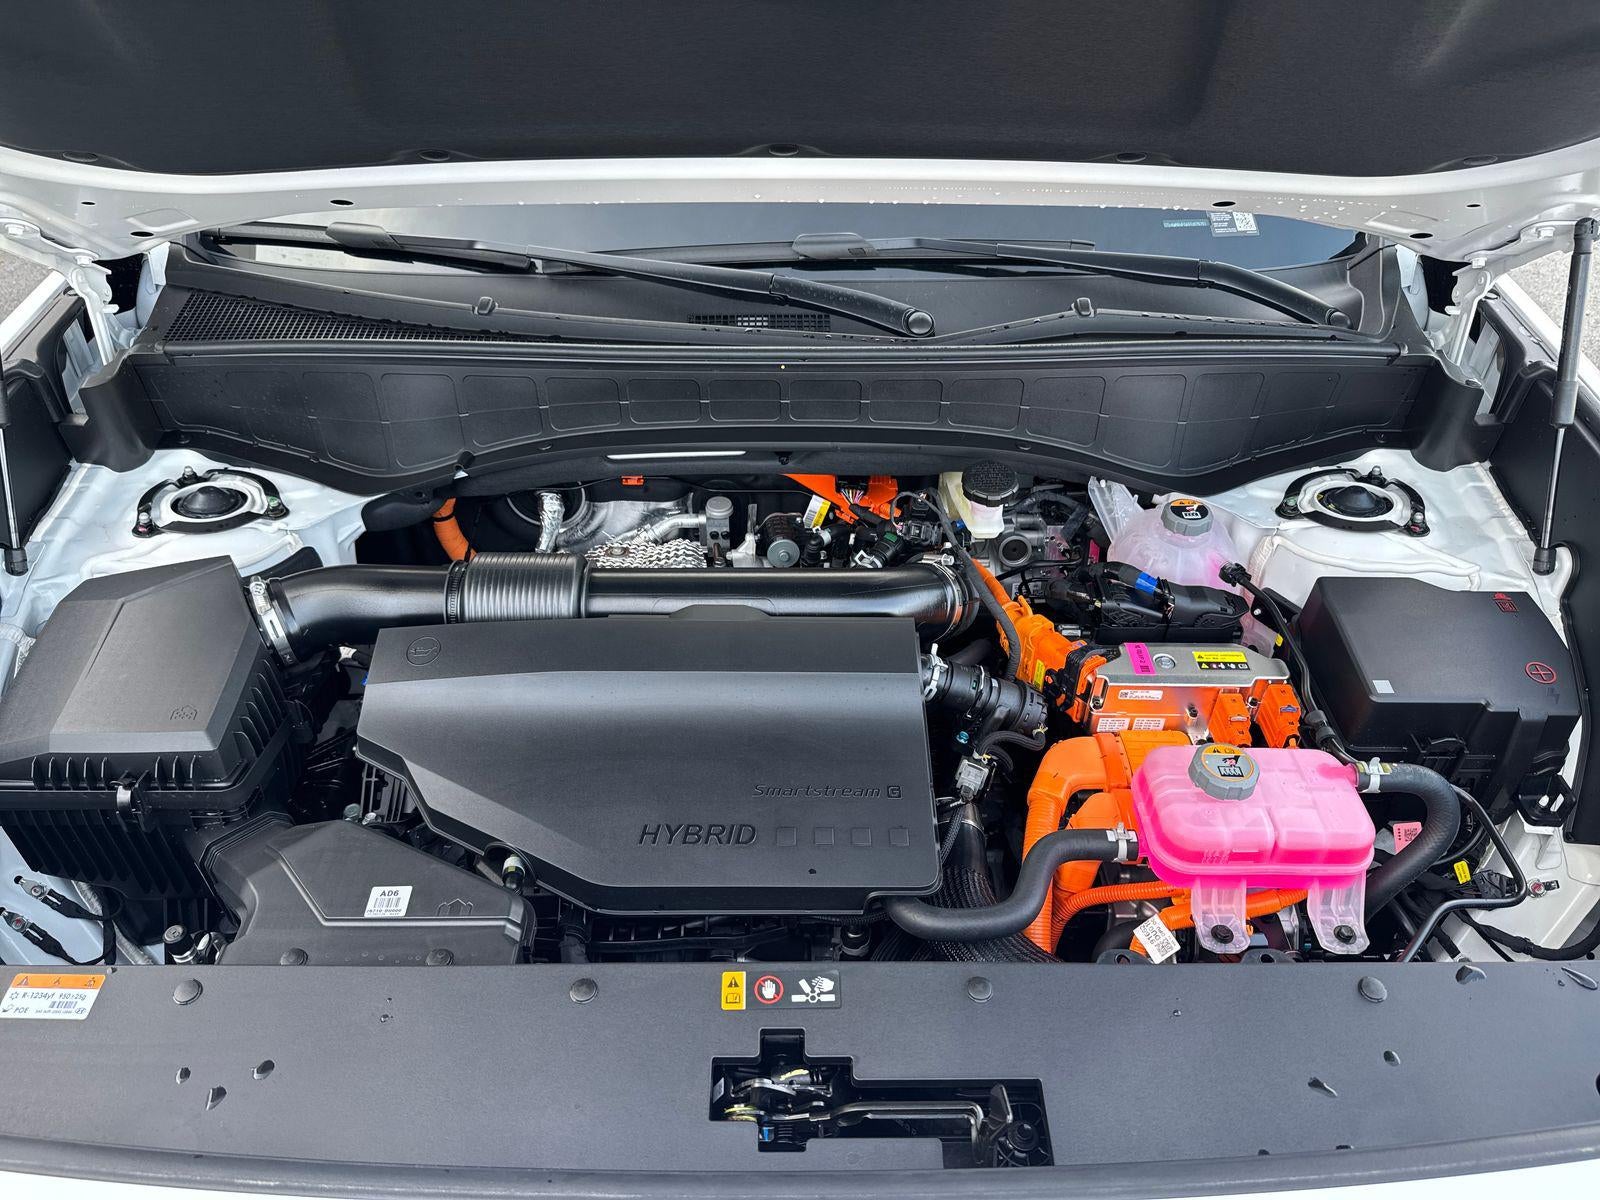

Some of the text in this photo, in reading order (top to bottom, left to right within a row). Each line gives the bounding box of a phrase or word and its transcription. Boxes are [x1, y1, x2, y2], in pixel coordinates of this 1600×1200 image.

[752, 783, 902, 799] Smartstream G
[638, 823, 758, 846] HYBRID
[379, 889, 400, 897] AD6
